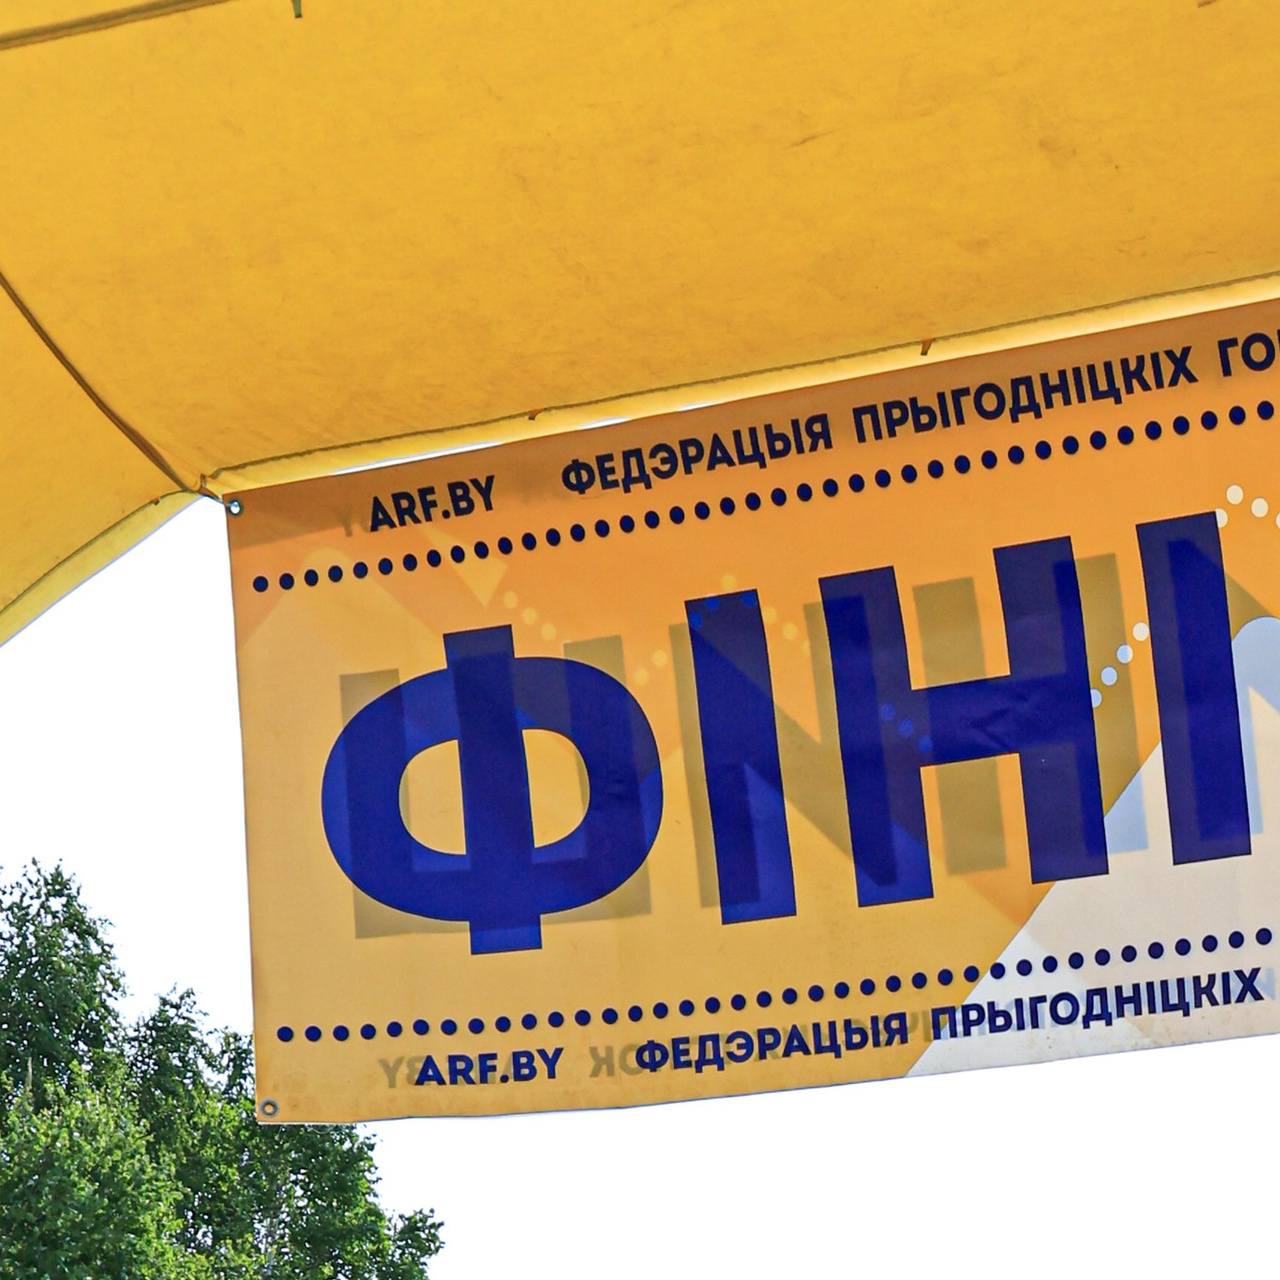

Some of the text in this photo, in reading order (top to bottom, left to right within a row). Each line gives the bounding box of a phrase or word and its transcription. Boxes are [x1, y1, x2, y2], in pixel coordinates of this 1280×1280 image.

[561, 414, 834, 497] ФЕДЭРАЦЫЯ
[853, 345, 1198, 444] ПРЫГОДНІЦКІХ
[368, 475, 497, 534] ARF.BY
[635, 1011, 910, 1074] ФЕДЭРАЦЫЯ
[932, 967, 1265, 1042] ПРЫГОДНІЦКІХ
[414, 1046, 564, 1087] ARF.BY
